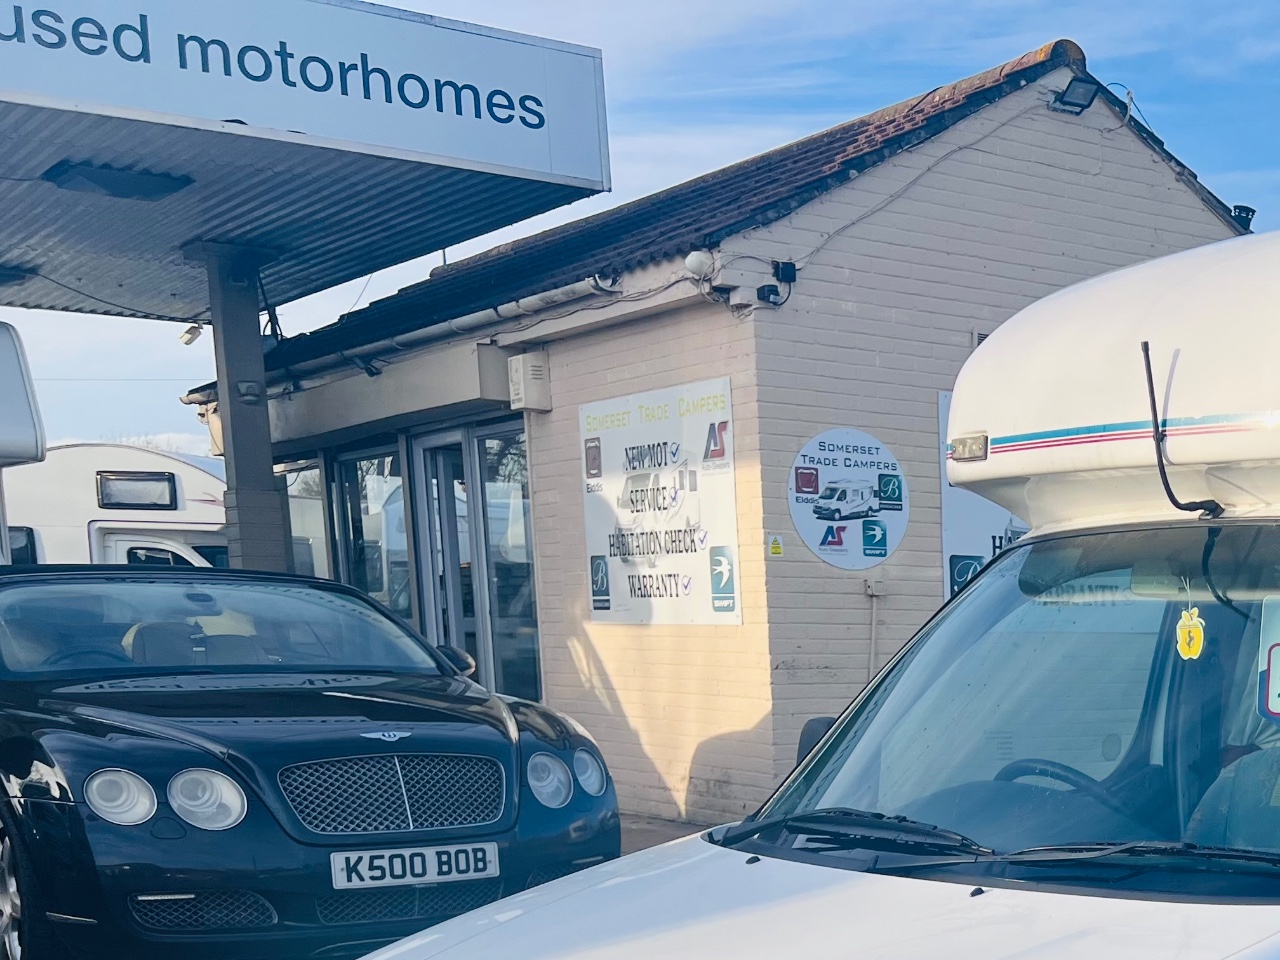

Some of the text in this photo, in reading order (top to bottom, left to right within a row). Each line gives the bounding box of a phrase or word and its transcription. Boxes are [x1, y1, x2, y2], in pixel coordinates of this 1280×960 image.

[0, 4, 546, 130] used motorhomes
[585, 394, 726, 433] SOMERSET TRADE CAMPERS
[624, 441, 668, 471] NEW MOT
[702, 420, 729, 462] AS
[818, 441, 881, 456] SOMERSET
[800, 454, 898, 471] TRADE CAMPERS
[629, 486, 668, 514] SERVICE
[608, 528, 698, 558] HABITATION CHECK
[819, 525, 848, 547] AS
[628, 573, 680, 598] WARRANTY
[344, 847, 488, 883] K500 BOB
